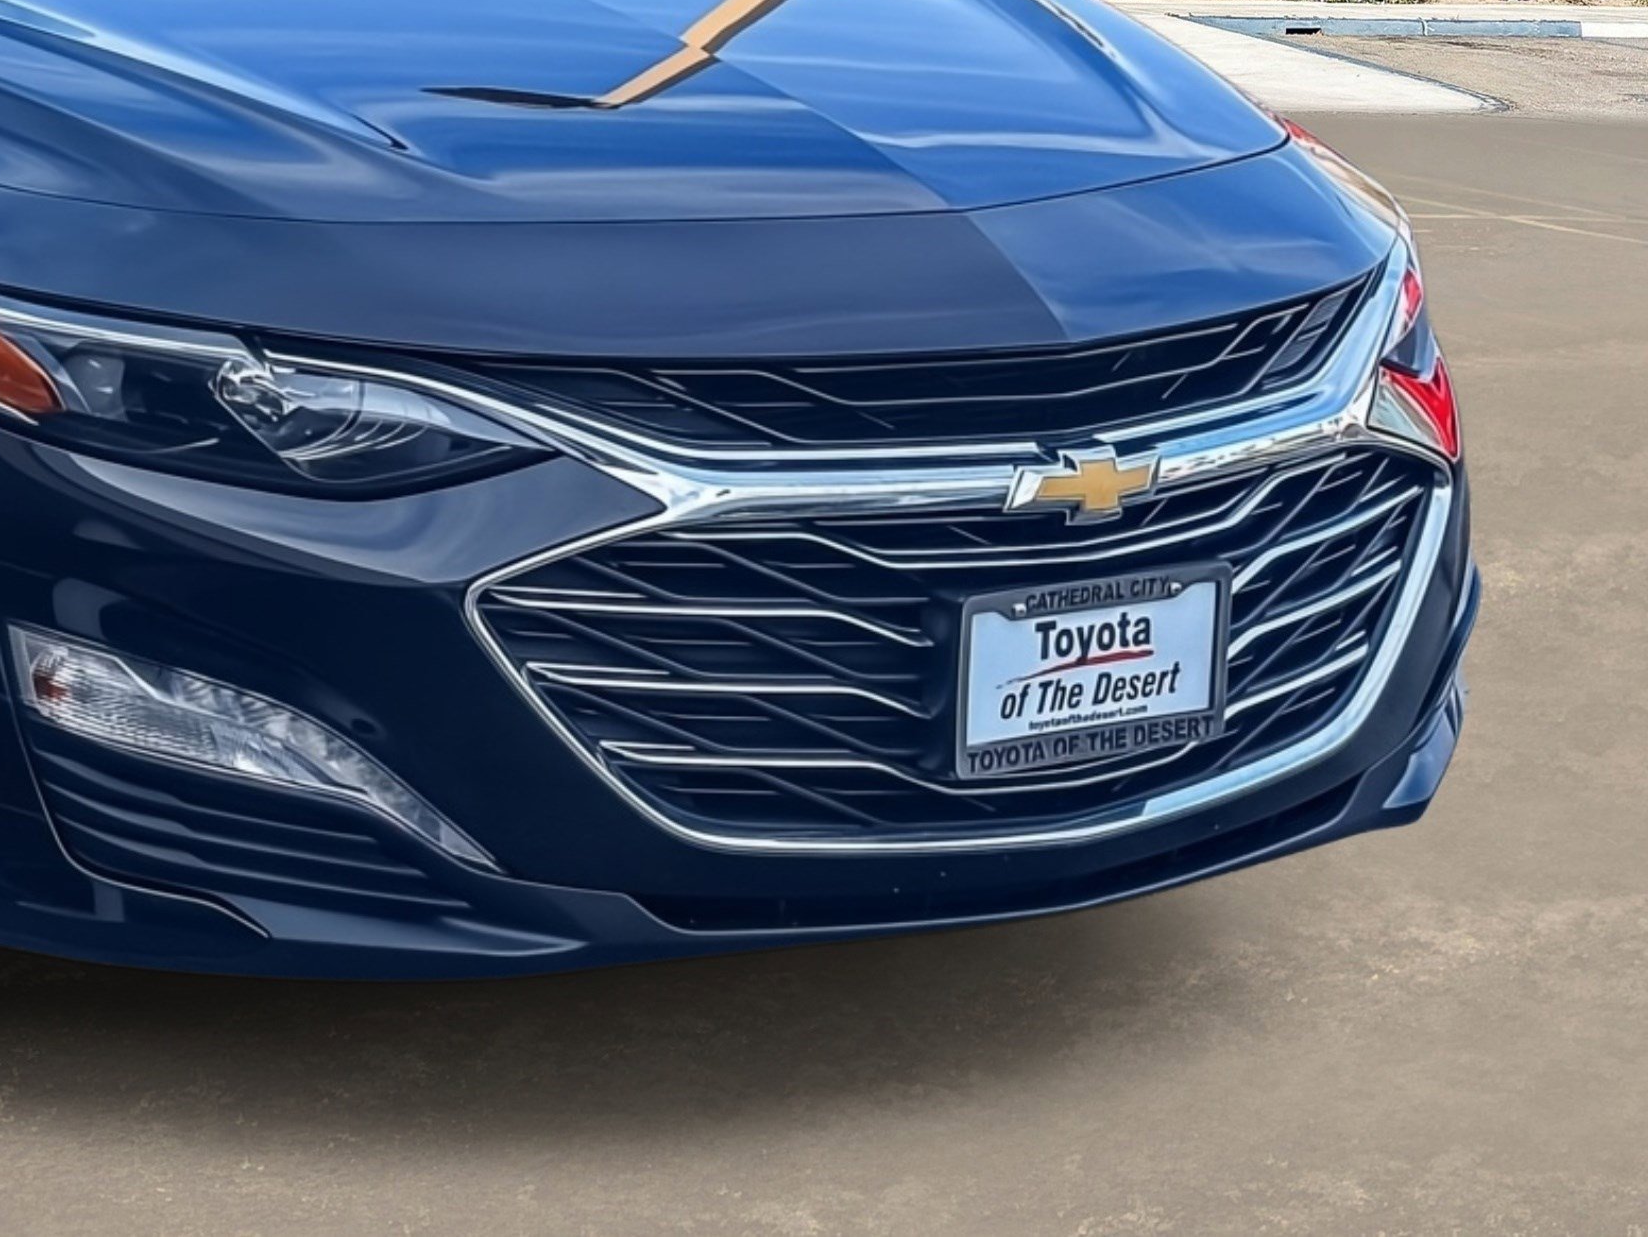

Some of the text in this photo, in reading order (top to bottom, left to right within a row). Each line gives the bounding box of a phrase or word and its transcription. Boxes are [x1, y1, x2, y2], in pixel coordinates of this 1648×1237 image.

[1025, 577, 1170, 610] CATHEDRAL CITY
[1035, 612, 1151, 660] Toyota
[999, 662, 1181, 720] of The Desert
[967, 716, 1214, 773] TOYOTA OF THE DESERT
